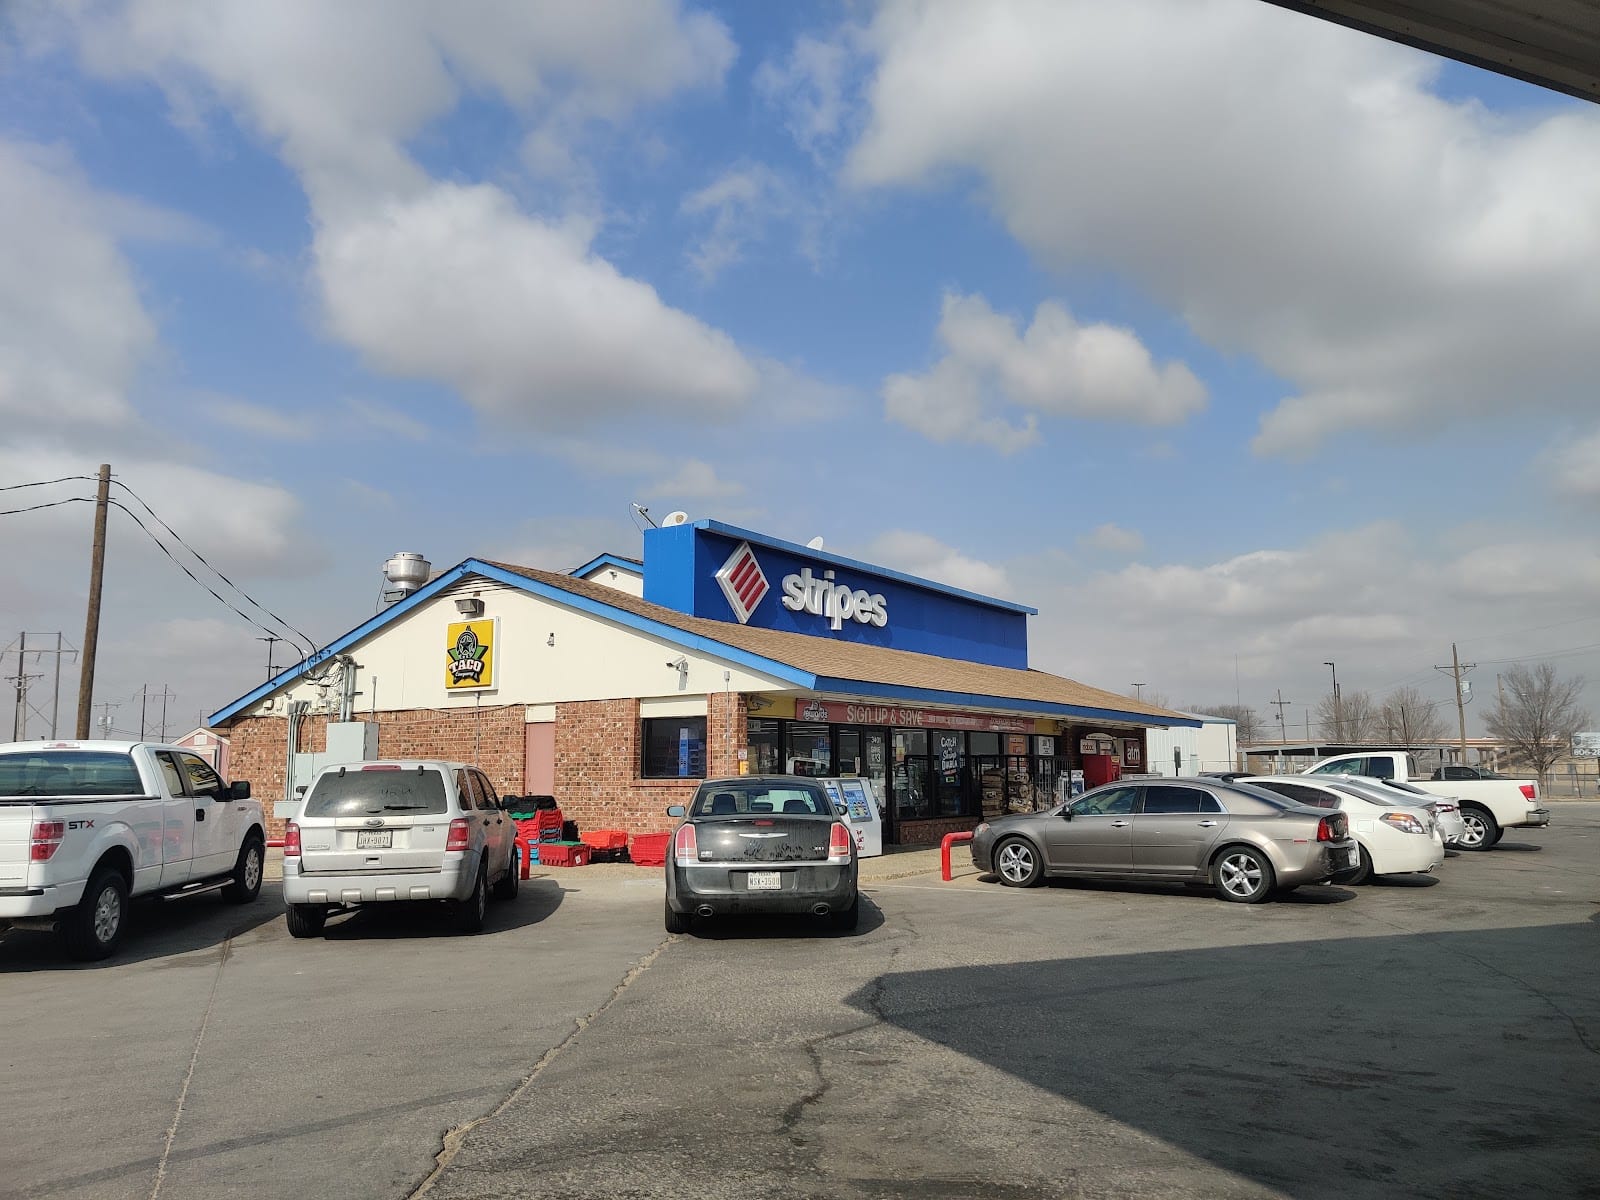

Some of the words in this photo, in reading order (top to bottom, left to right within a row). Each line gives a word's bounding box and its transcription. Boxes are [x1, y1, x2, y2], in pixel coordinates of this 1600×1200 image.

[781, 567, 888, 631] stripes
[448, 659, 483, 673] TACO
[846, 705, 871, 723] SIGN
[875, 708, 888, 724] UP
[889, 709, 897, 725] &
[899, 710, 924, 726] SAVE
[1127, 746, 1140, 761] atm
[69, 820, 95, 830] STX
